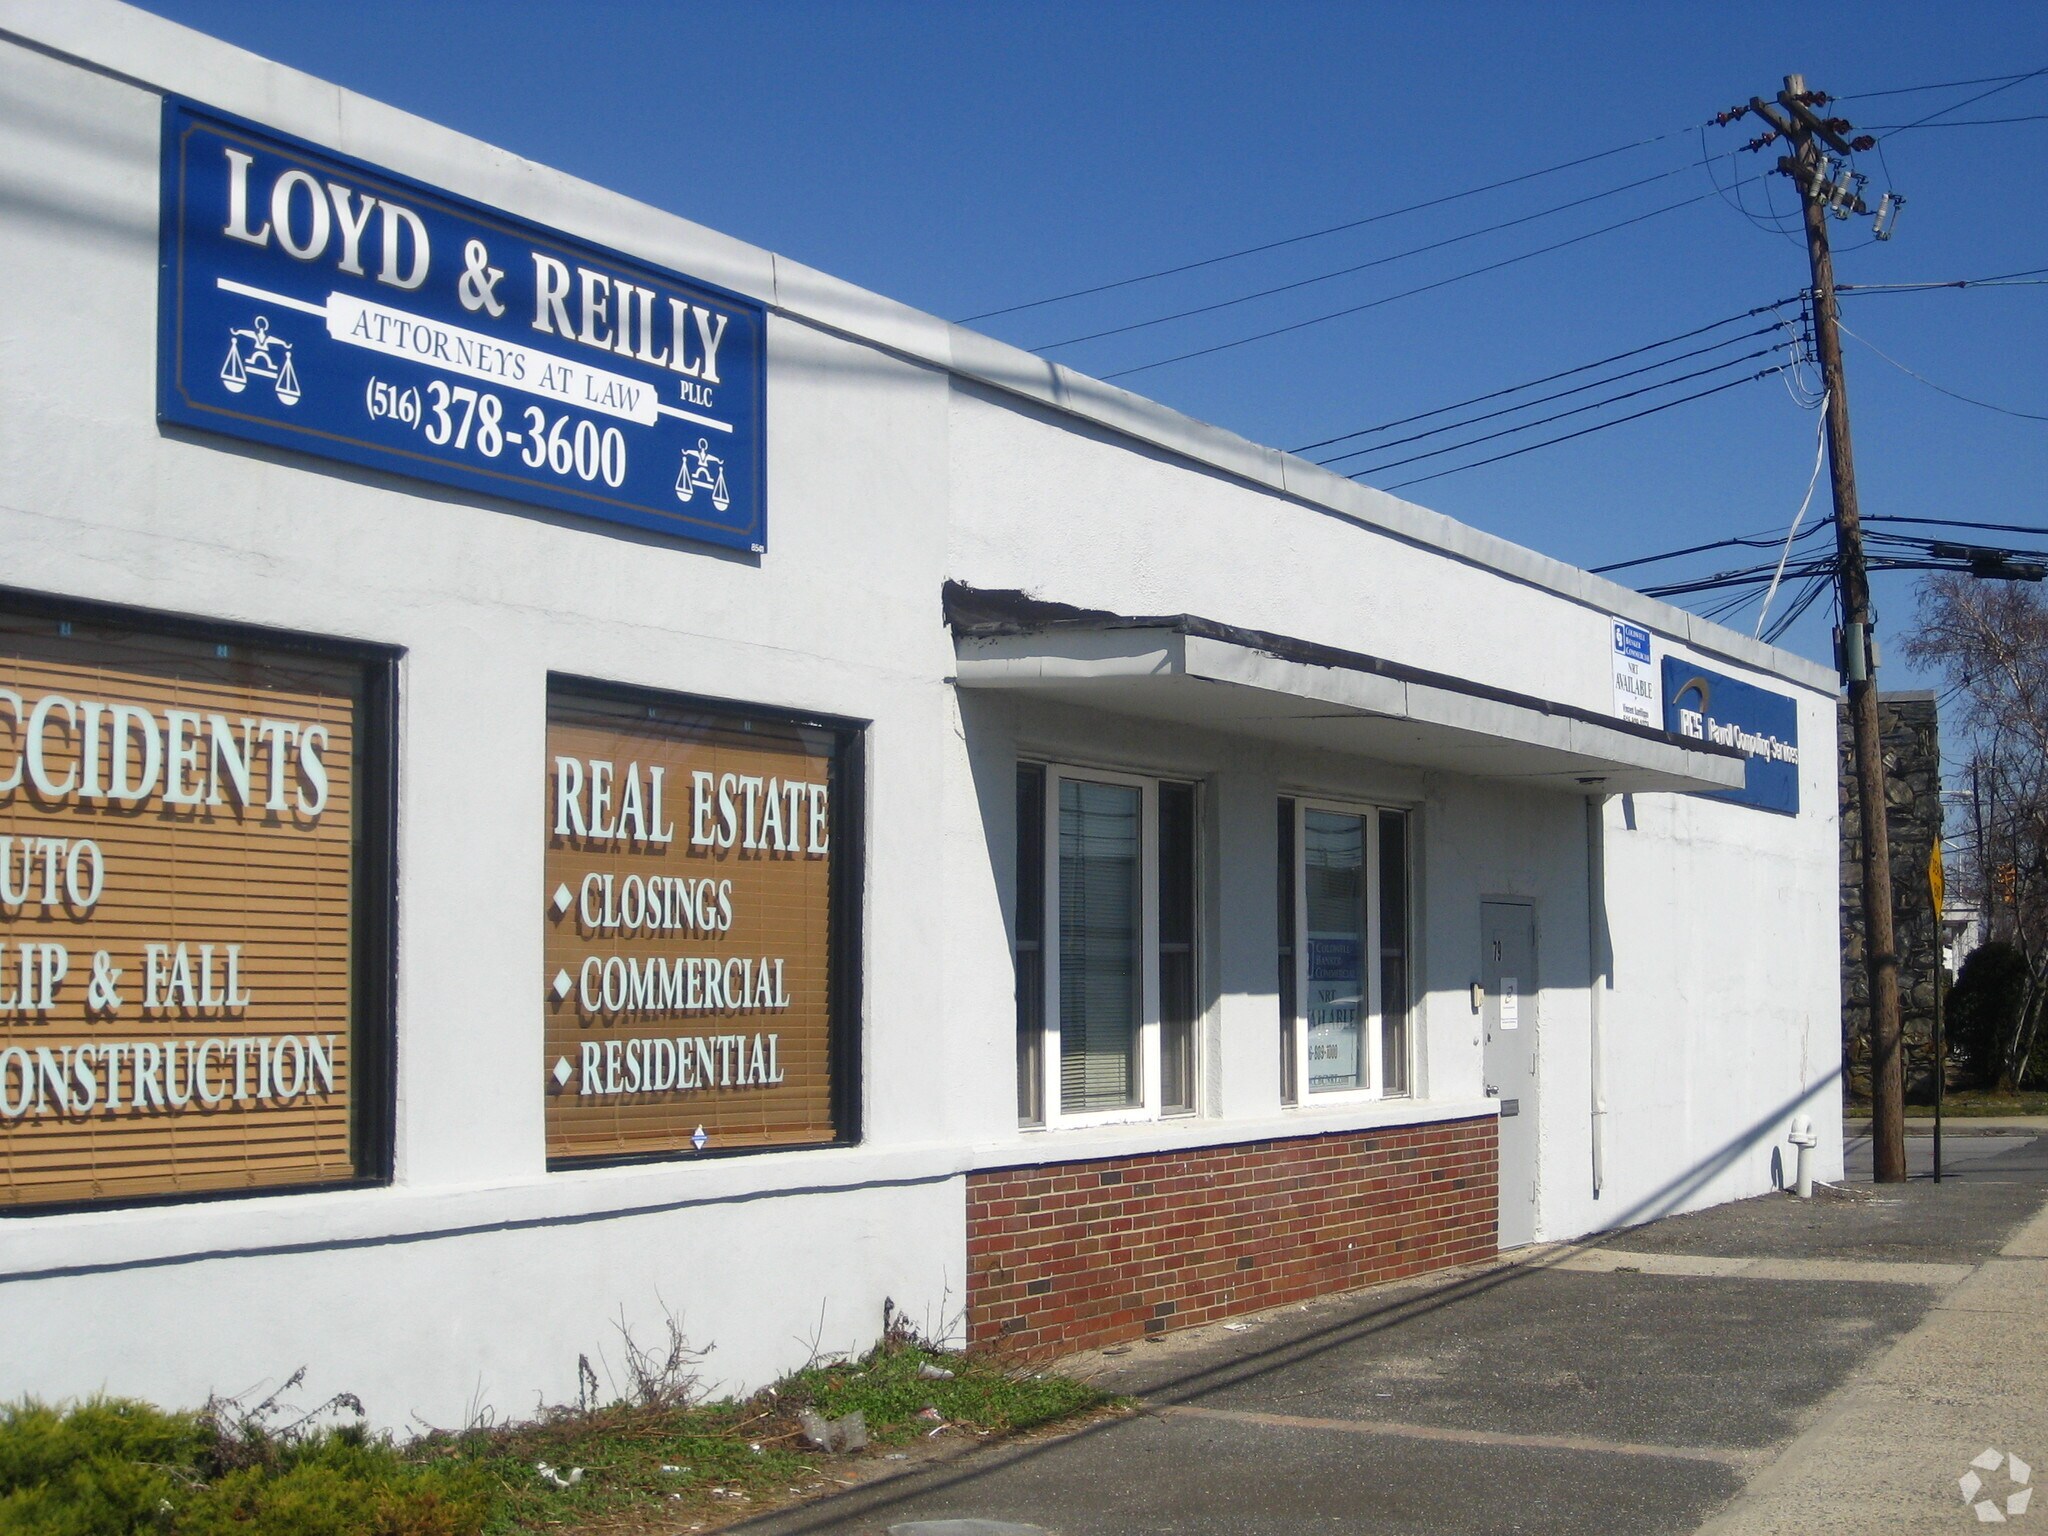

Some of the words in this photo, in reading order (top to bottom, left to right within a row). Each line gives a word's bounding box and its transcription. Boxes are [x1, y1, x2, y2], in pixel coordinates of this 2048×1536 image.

[223, 147, 432, 291] LOYD
[457, 238, 506, 318] &
[531, 251, 729, 385] REILLY
[351, 309, 527, 382] ATTORNEYS
[538, 365, 573, 394] AT
[585, 374, 641, 413] LAW
[680, 380, 714, 409] PLLC
[1616, 672, 1653, 700] AVAILABLE
[1769, 735, 1799, 765] Services
[554, 756, 674, 843] REAL
[691, 770, 829, 854] ESTATE
[580, 872, 733, 931] CLOSINGS
[88, 950, 124, 1010] &
[143, 941, 251, 1009] FALL
[580, 956, 790, 1012] COMMERCIAL
[1318, 990, 1336, 1003] NRT
[580, 1033, 784, 1096] RESIDENTIAL
